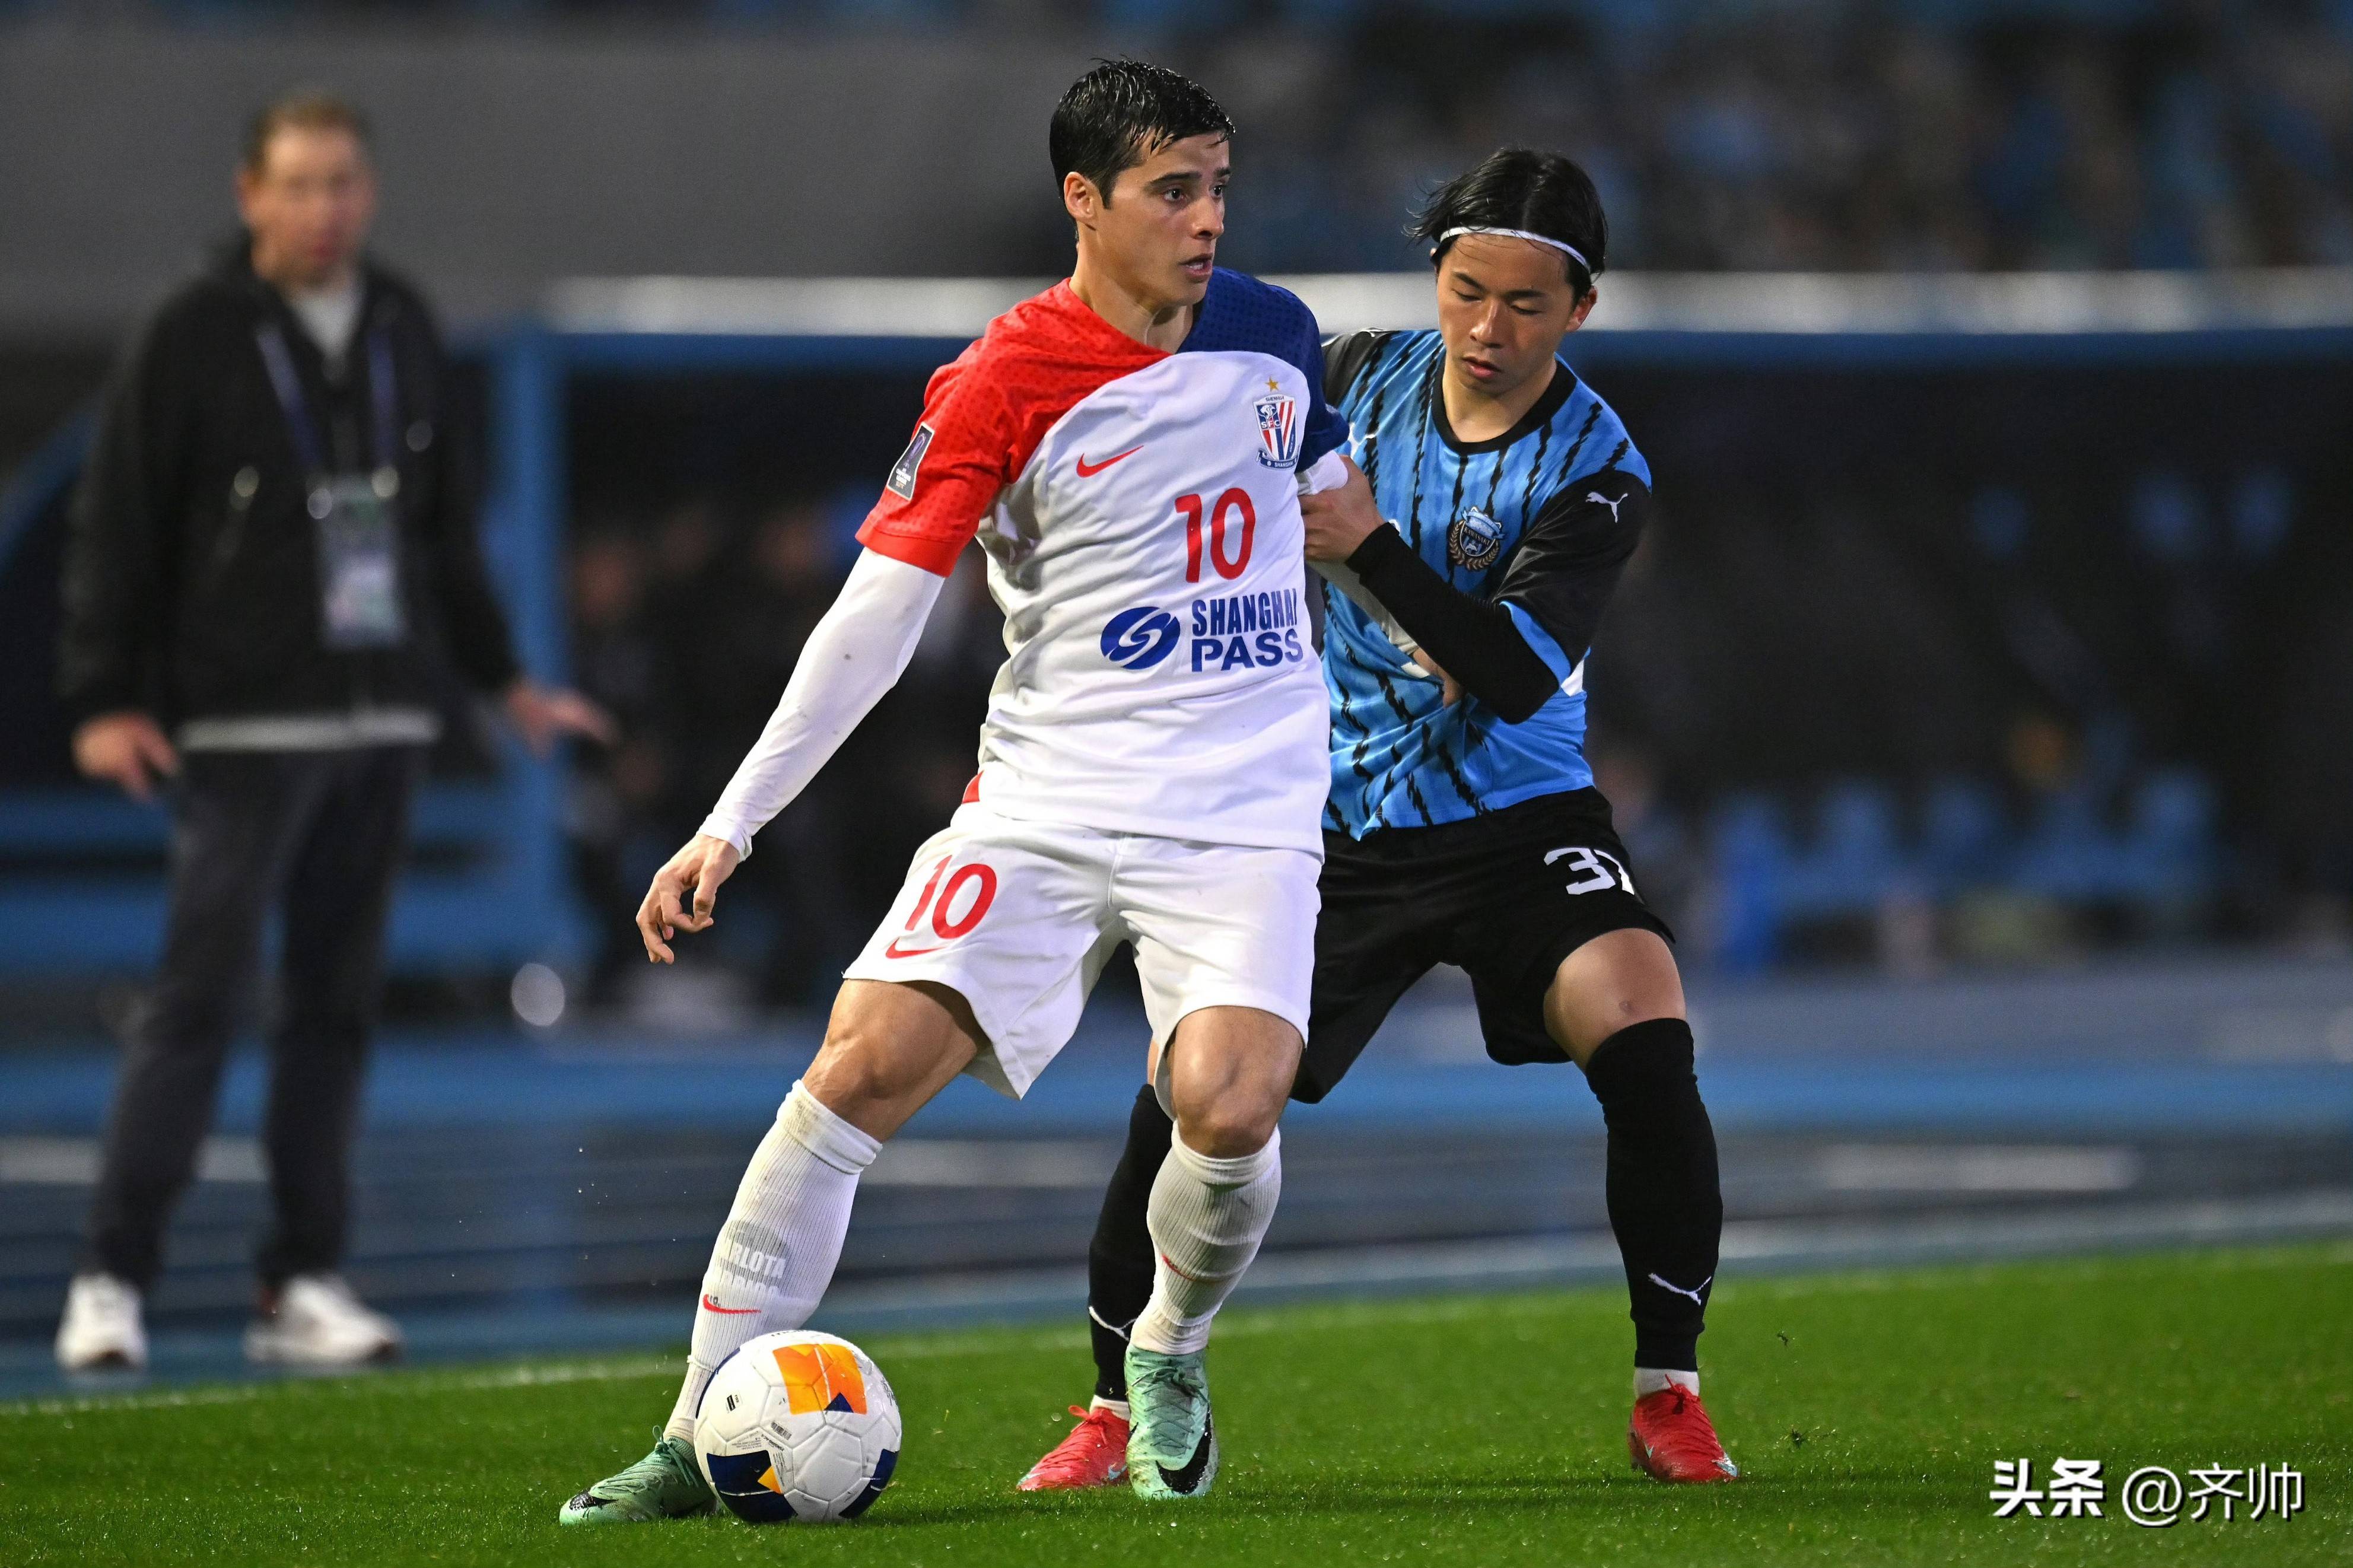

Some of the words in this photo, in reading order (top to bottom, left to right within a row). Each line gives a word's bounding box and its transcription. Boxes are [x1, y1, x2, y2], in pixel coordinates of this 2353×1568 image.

[1261, 420, 1281, 428] SFC
[1175, 487, 1255, 583] 10
[1191, 588, 1298, 637] SHANGHAI
[1191, 628, 1303, 672] PASS
[905, 854, 997, 939] 10
